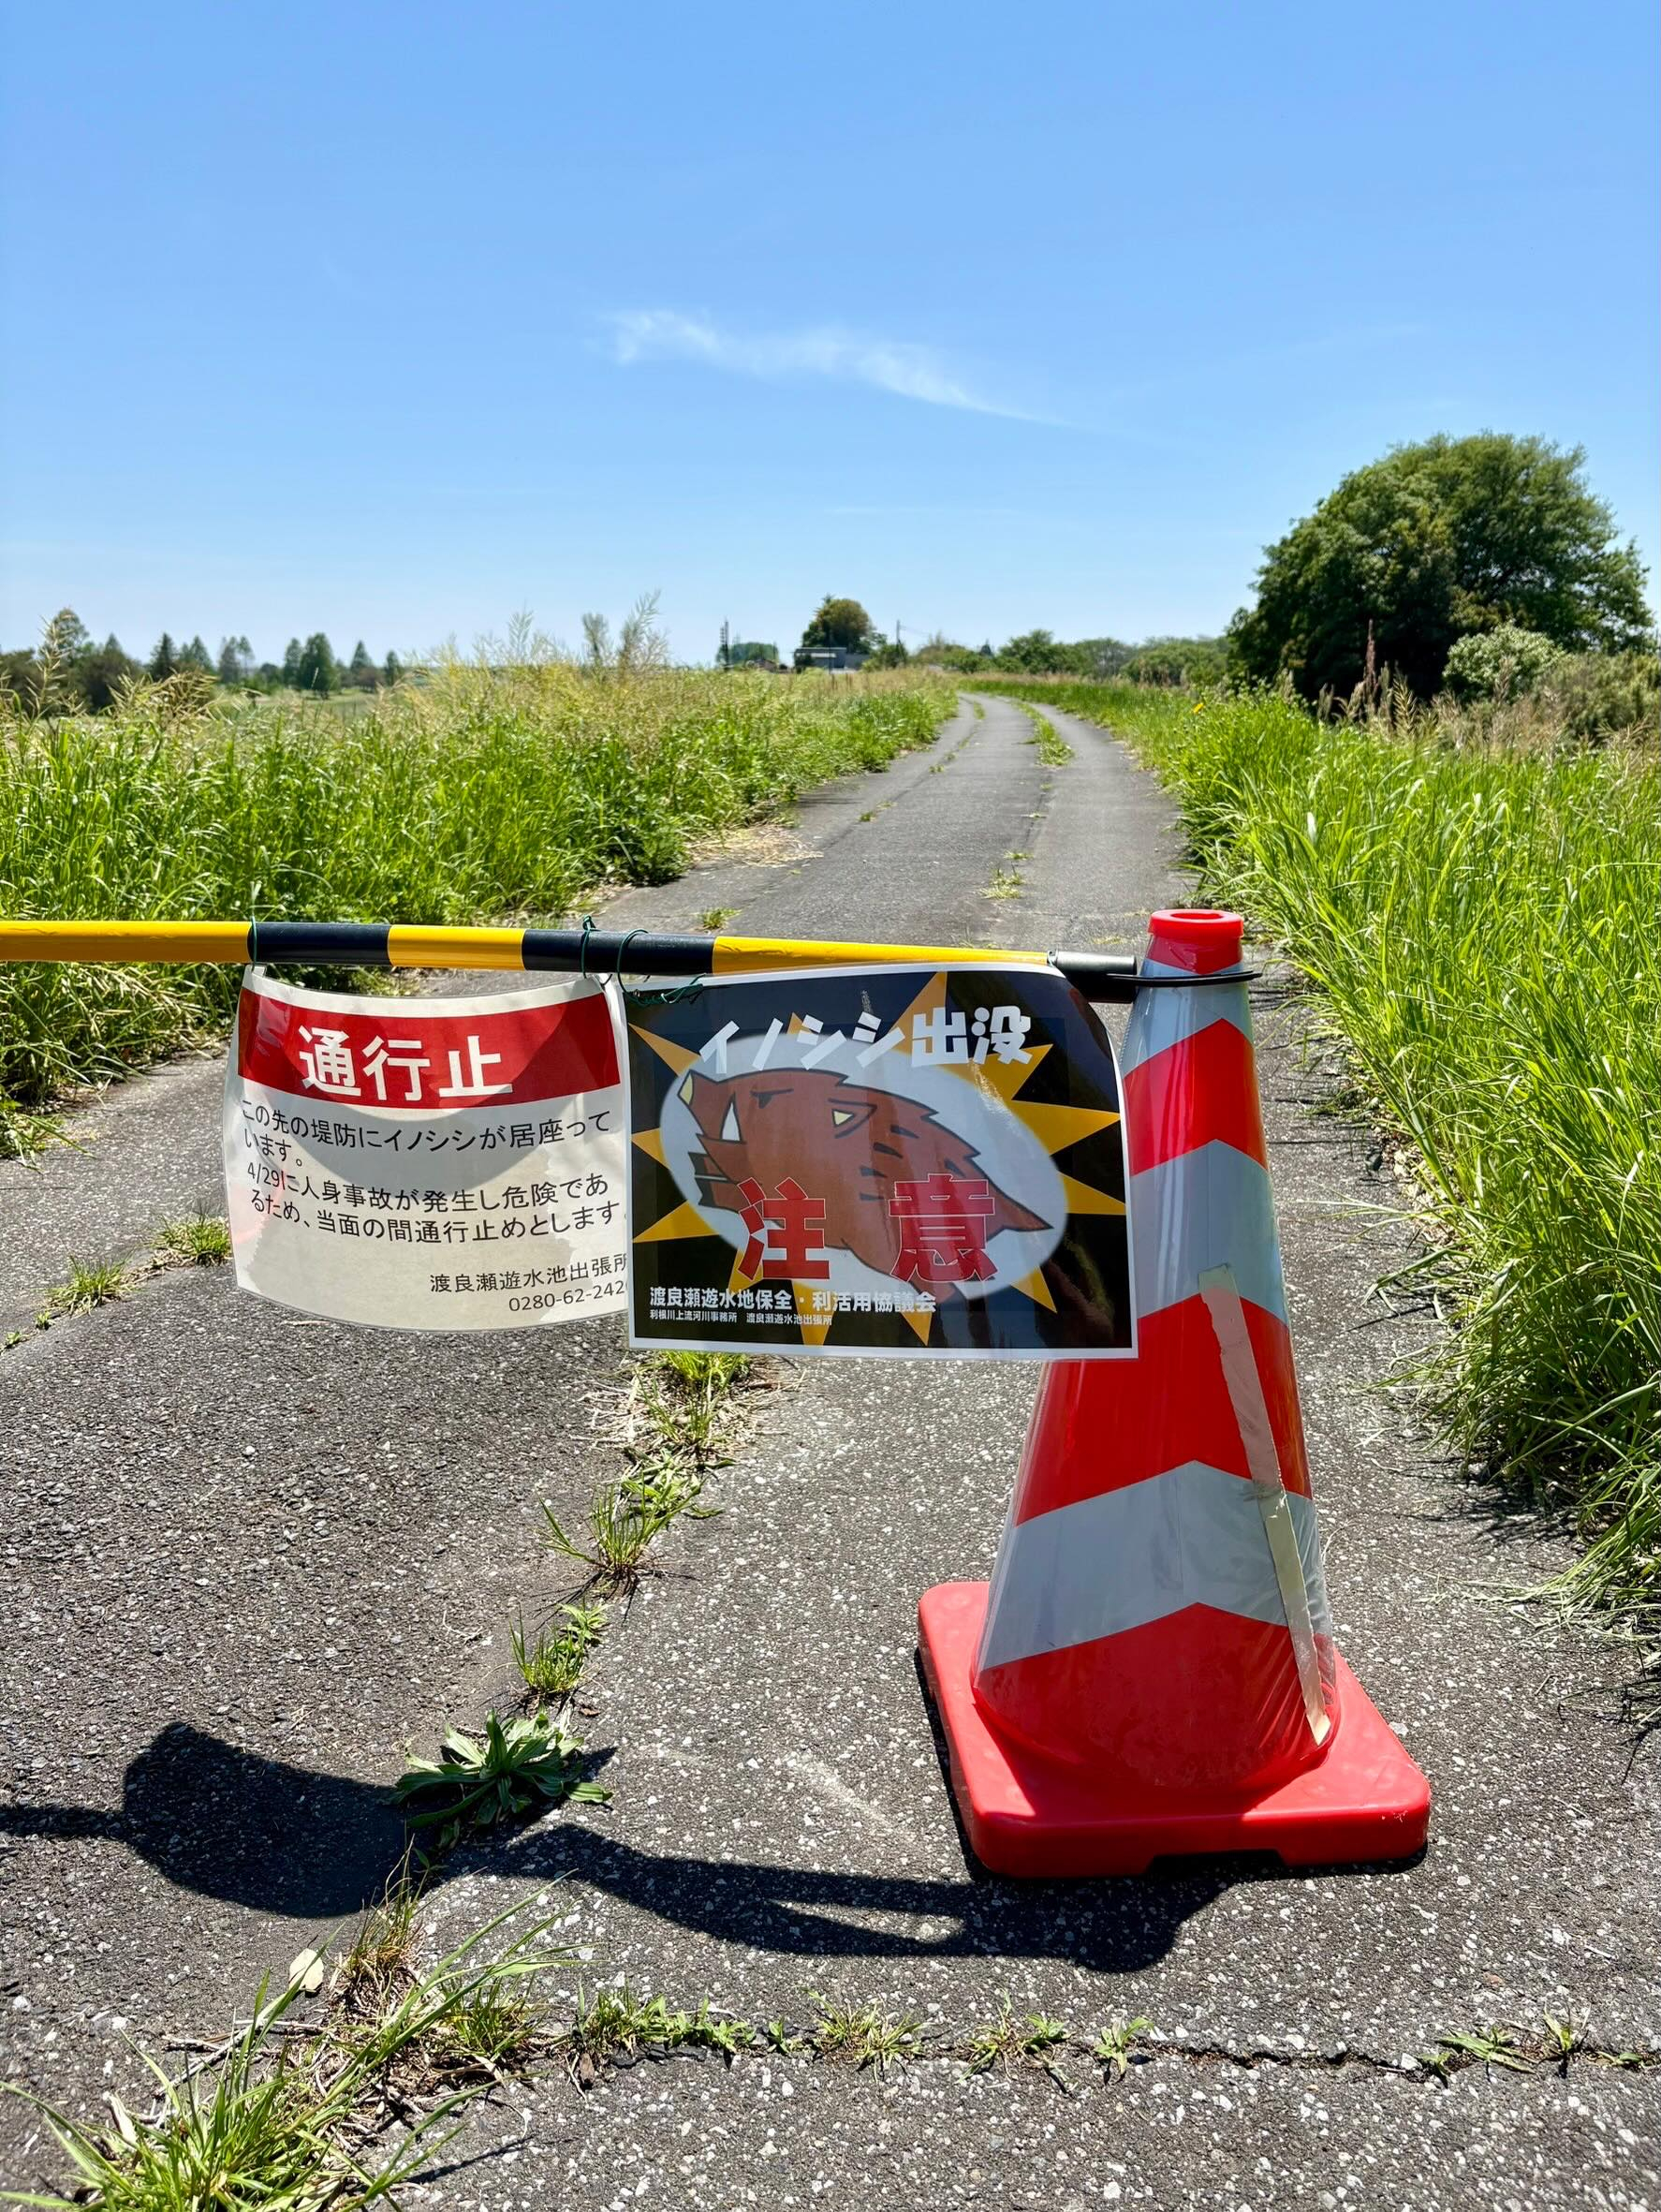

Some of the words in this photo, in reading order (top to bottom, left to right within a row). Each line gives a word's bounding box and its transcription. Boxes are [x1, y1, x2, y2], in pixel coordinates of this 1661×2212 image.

[299, 1025, 513, 1101] 通行止
[699, 1005, 1033, 1074] イノシシ出没
[243, 1099, 611, 1153] この先の堤防にイノシシが居座って
[244, 1128, 302, 1167] います。
[247, 1162, 609, 1215] 4/29に人身事故が発生し危険であ
[251, 1189, 627, 1245] るため、当面の間通行止めとします
[509, 1280, 628, 1312] 0280-62-242
